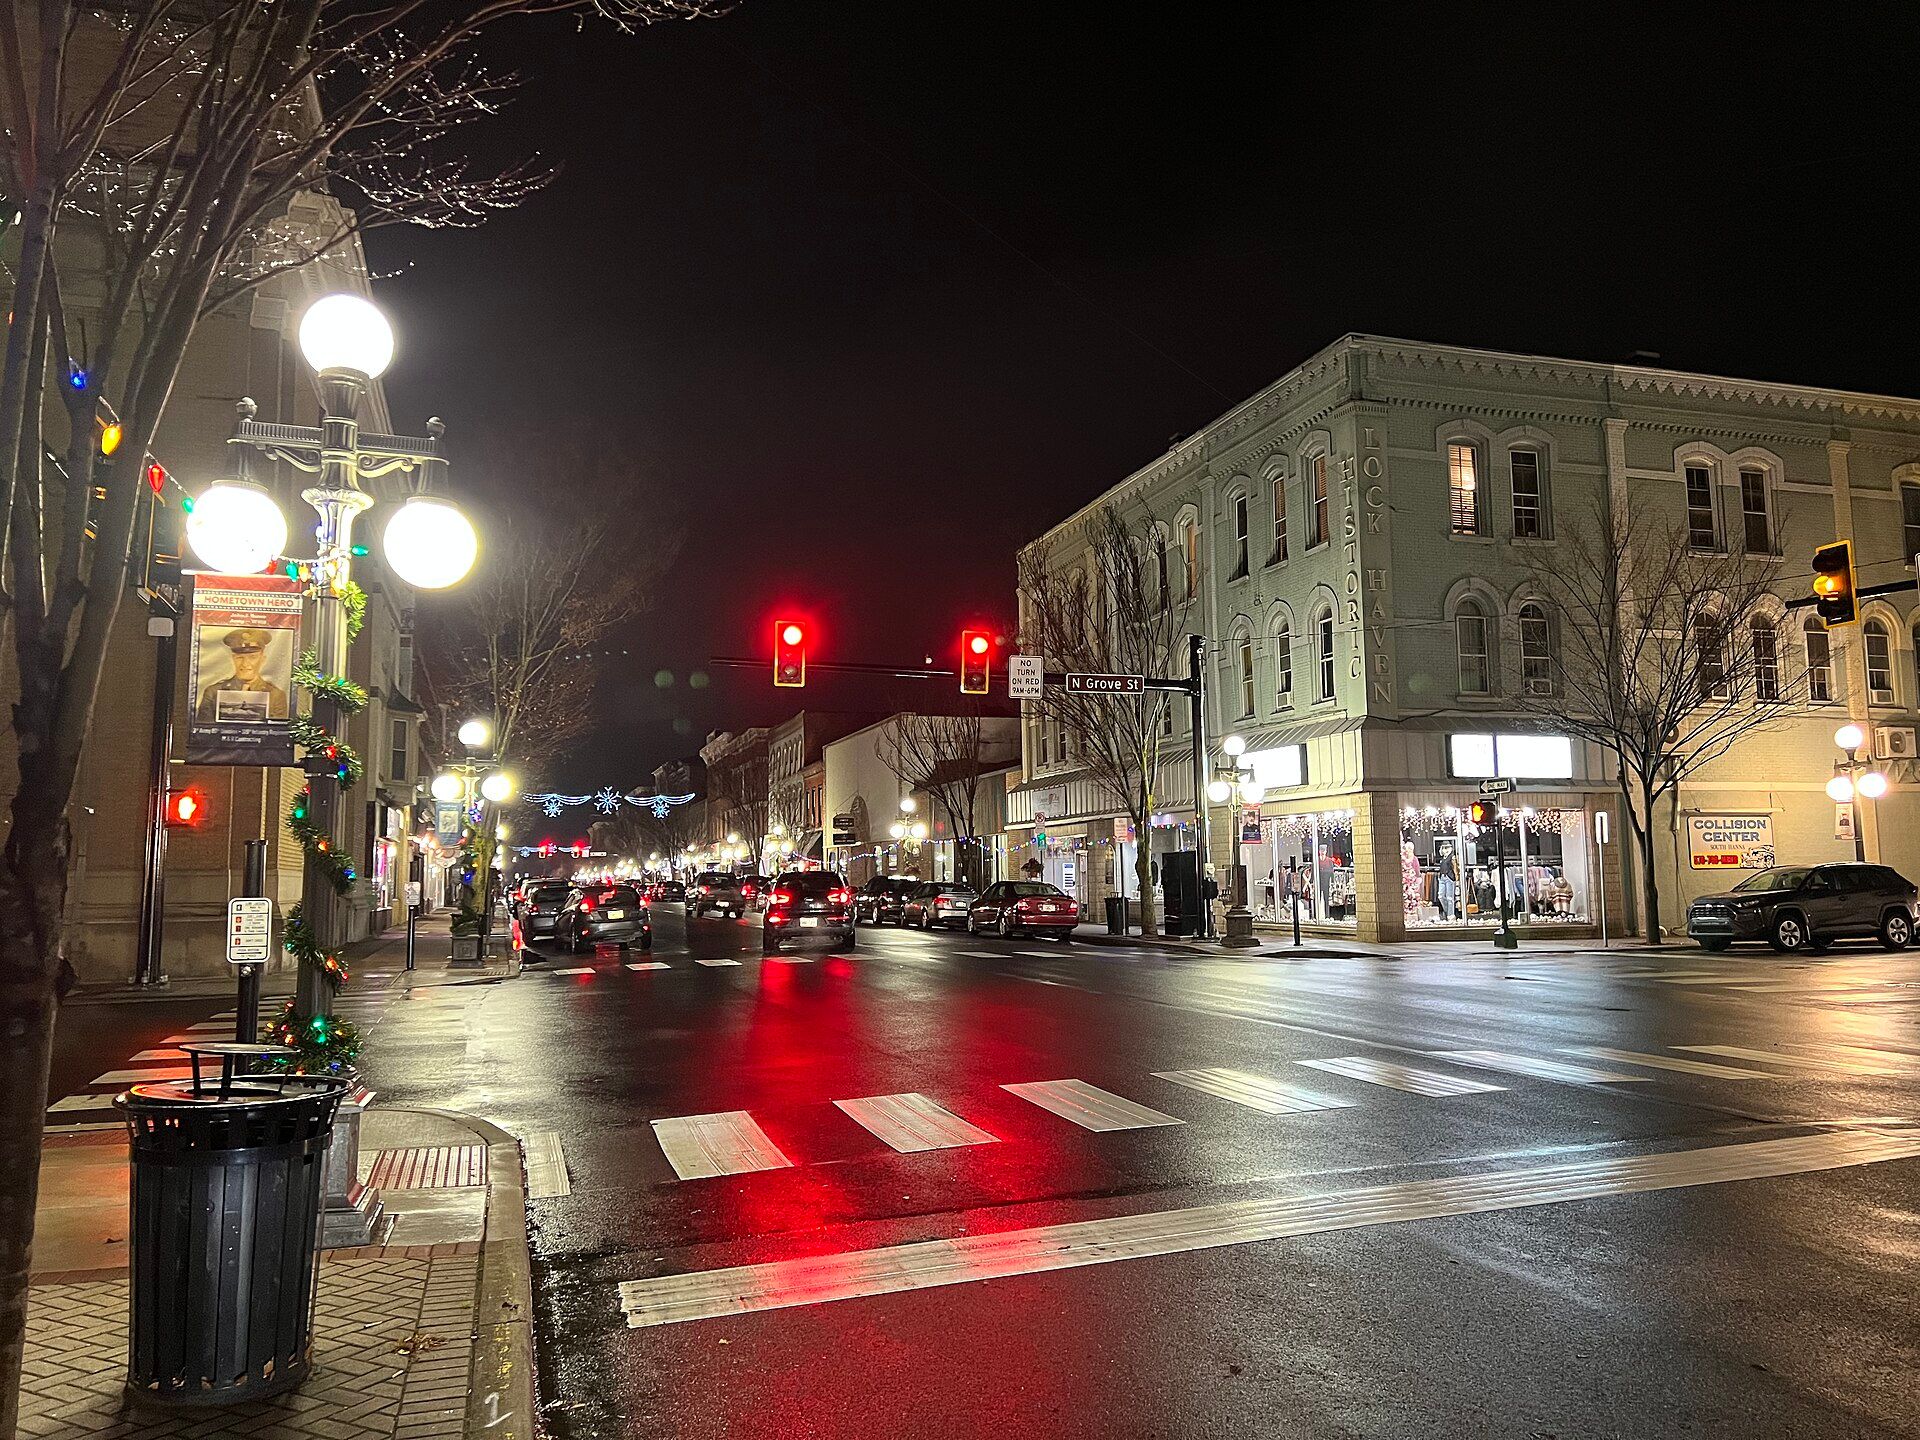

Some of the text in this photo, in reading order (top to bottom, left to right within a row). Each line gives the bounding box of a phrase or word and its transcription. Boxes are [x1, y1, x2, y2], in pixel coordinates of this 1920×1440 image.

[1338, 456, 1361, 680] HISTORIC
[1363, 427, 1393, 704] LOCK HAVEN
[204, 595, 294, 608] HOMETOWN HERO
[1072, 677, 1139, 690] N Grove St
[1012, 687, 1040, 695] 9AM-6PM
[1693, 820, 1767, 830] COLLISION
[1702, 832, 1761, 842] CENTER
